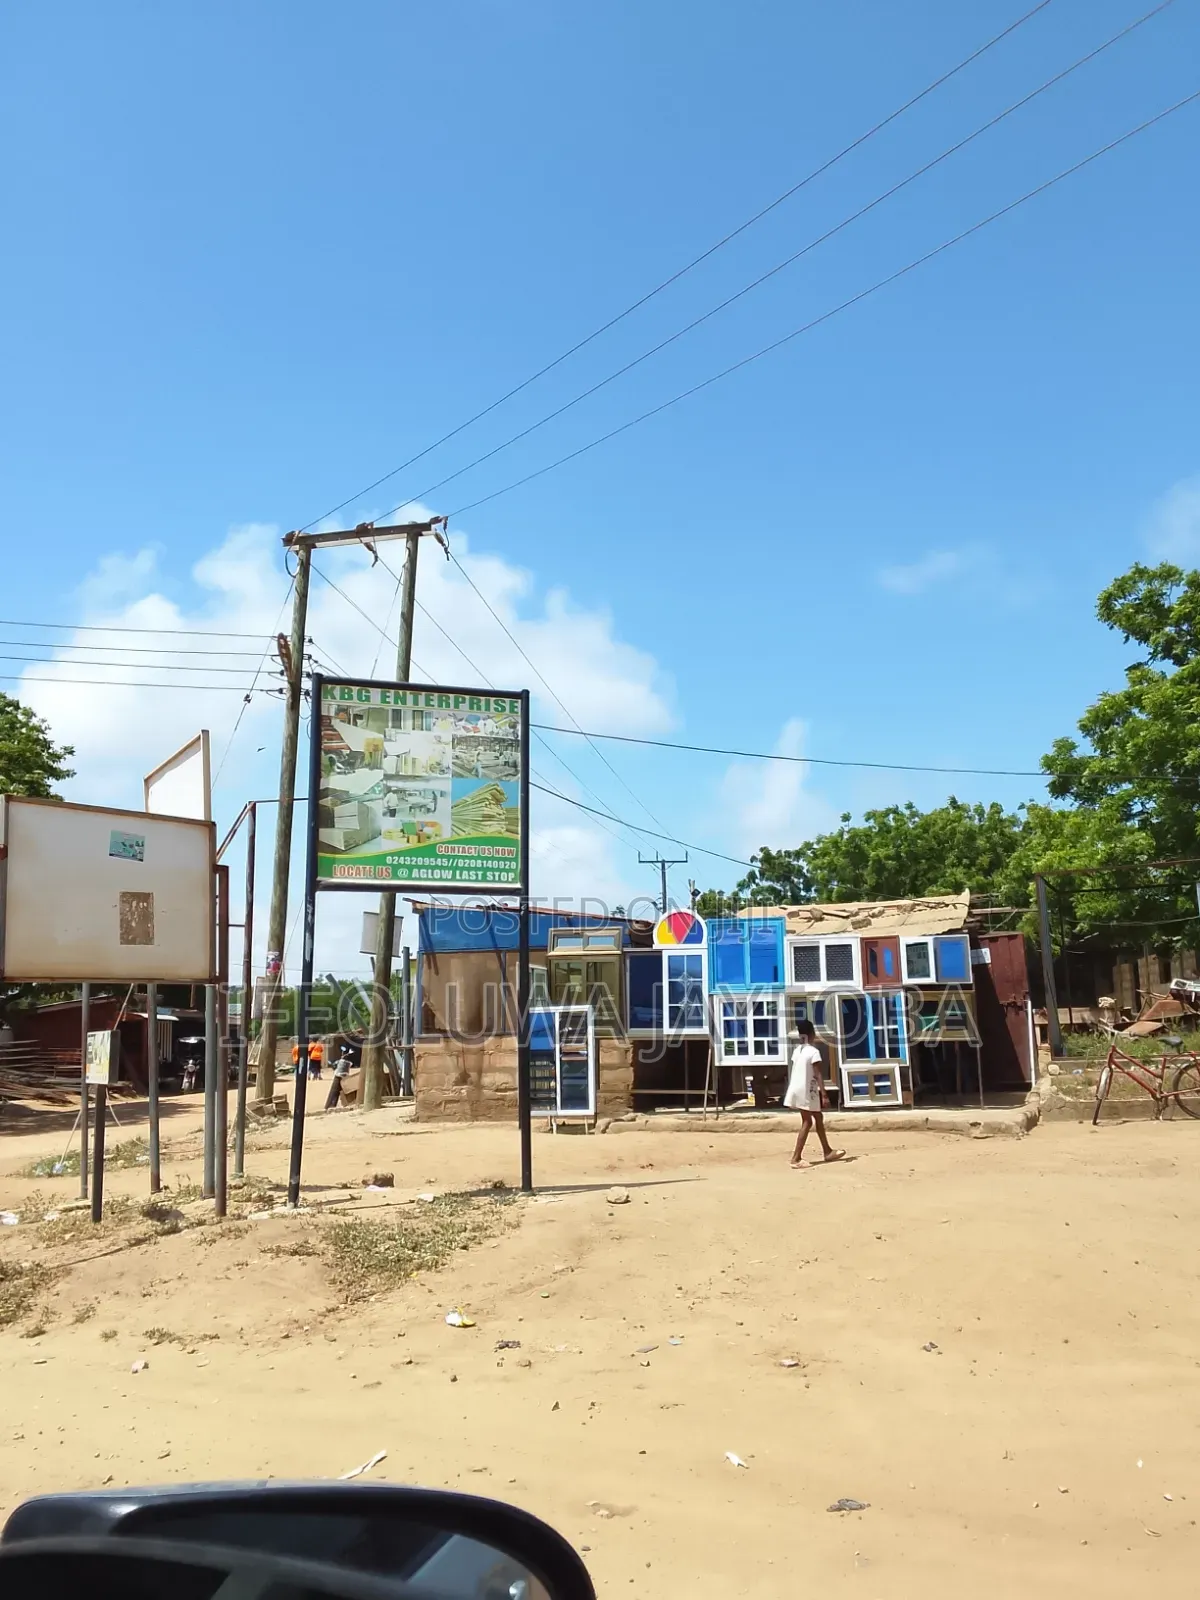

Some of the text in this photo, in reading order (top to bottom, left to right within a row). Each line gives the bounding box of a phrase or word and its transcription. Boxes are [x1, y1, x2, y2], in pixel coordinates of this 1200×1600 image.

[322, 684, 520, 714] KBG ENTERPRISE
[436, 844, 516, 858] CONTACT US NOW
[333, 865, 516, 882] LOCATE US @ AGLOW LAST STOP
